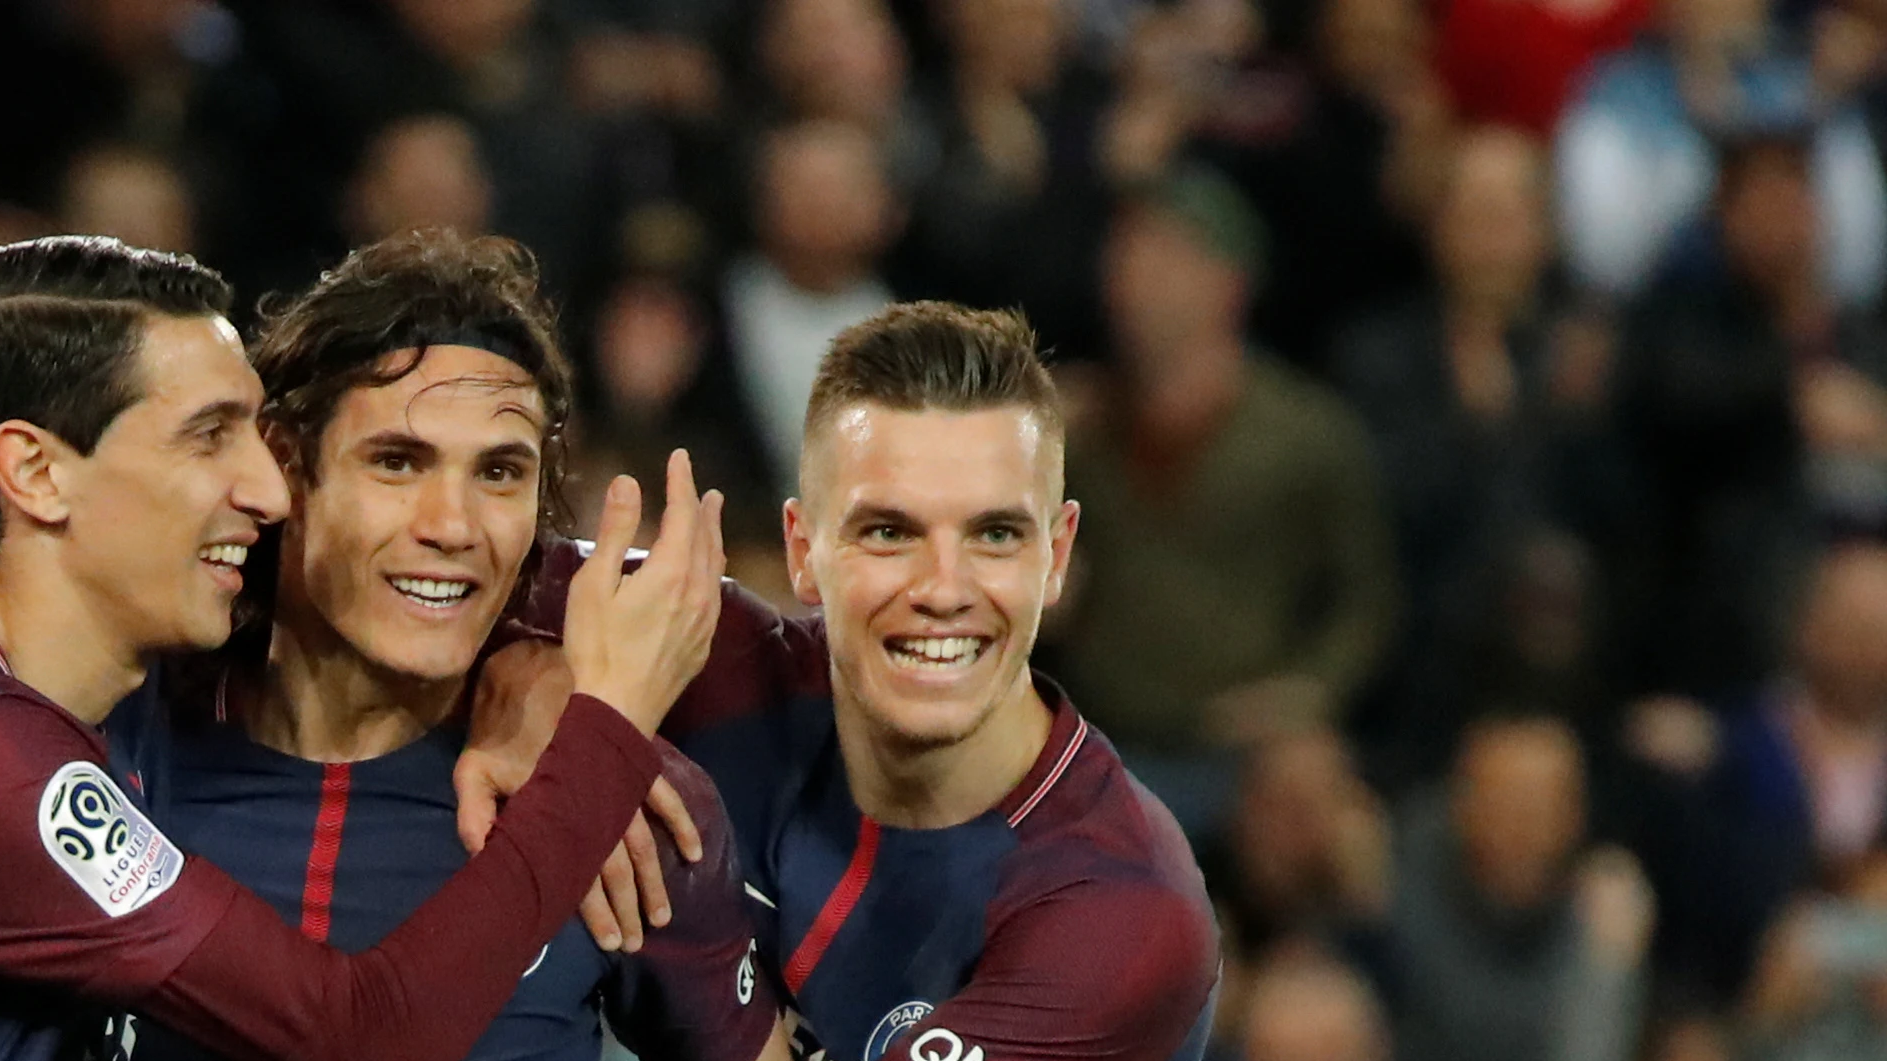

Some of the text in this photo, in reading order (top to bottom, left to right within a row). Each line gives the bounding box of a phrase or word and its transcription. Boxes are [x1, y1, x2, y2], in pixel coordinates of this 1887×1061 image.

[102, 835, 145, 888] LIGUE
[109, 834, 162, 904] Conforama
[890, 1006, 931, 1028] PAR
